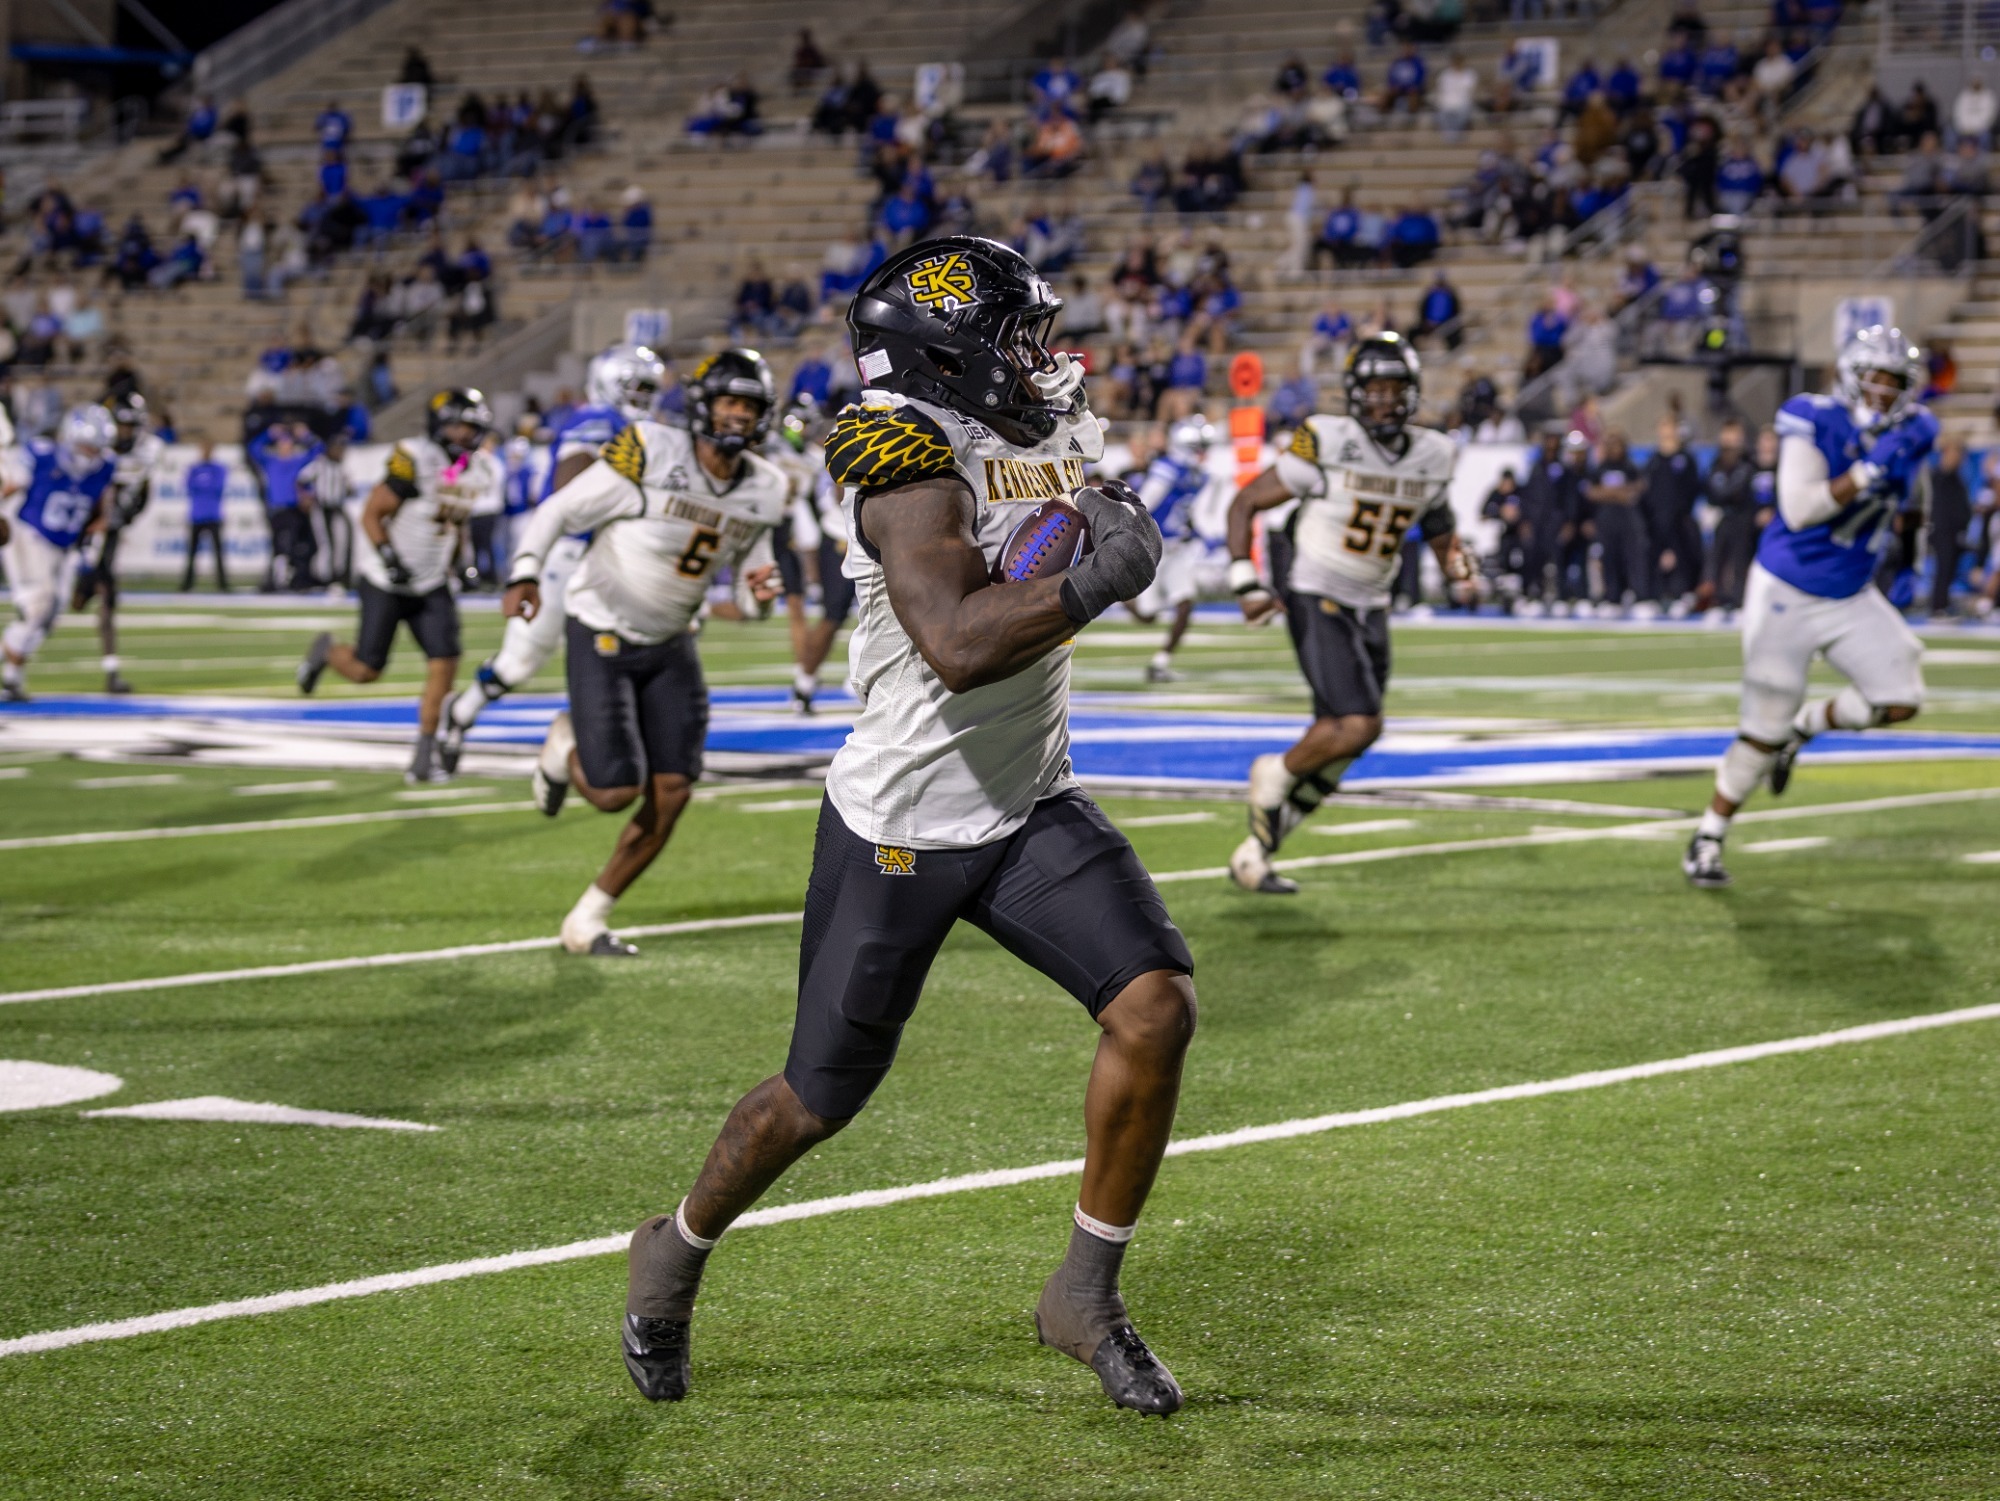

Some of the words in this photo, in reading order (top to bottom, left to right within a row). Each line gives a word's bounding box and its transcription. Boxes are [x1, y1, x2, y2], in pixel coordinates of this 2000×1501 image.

[962, 425, 996, 441] USA
[676, 526, 721, 579] 6
[1343, 499, 1417, 557] 55
